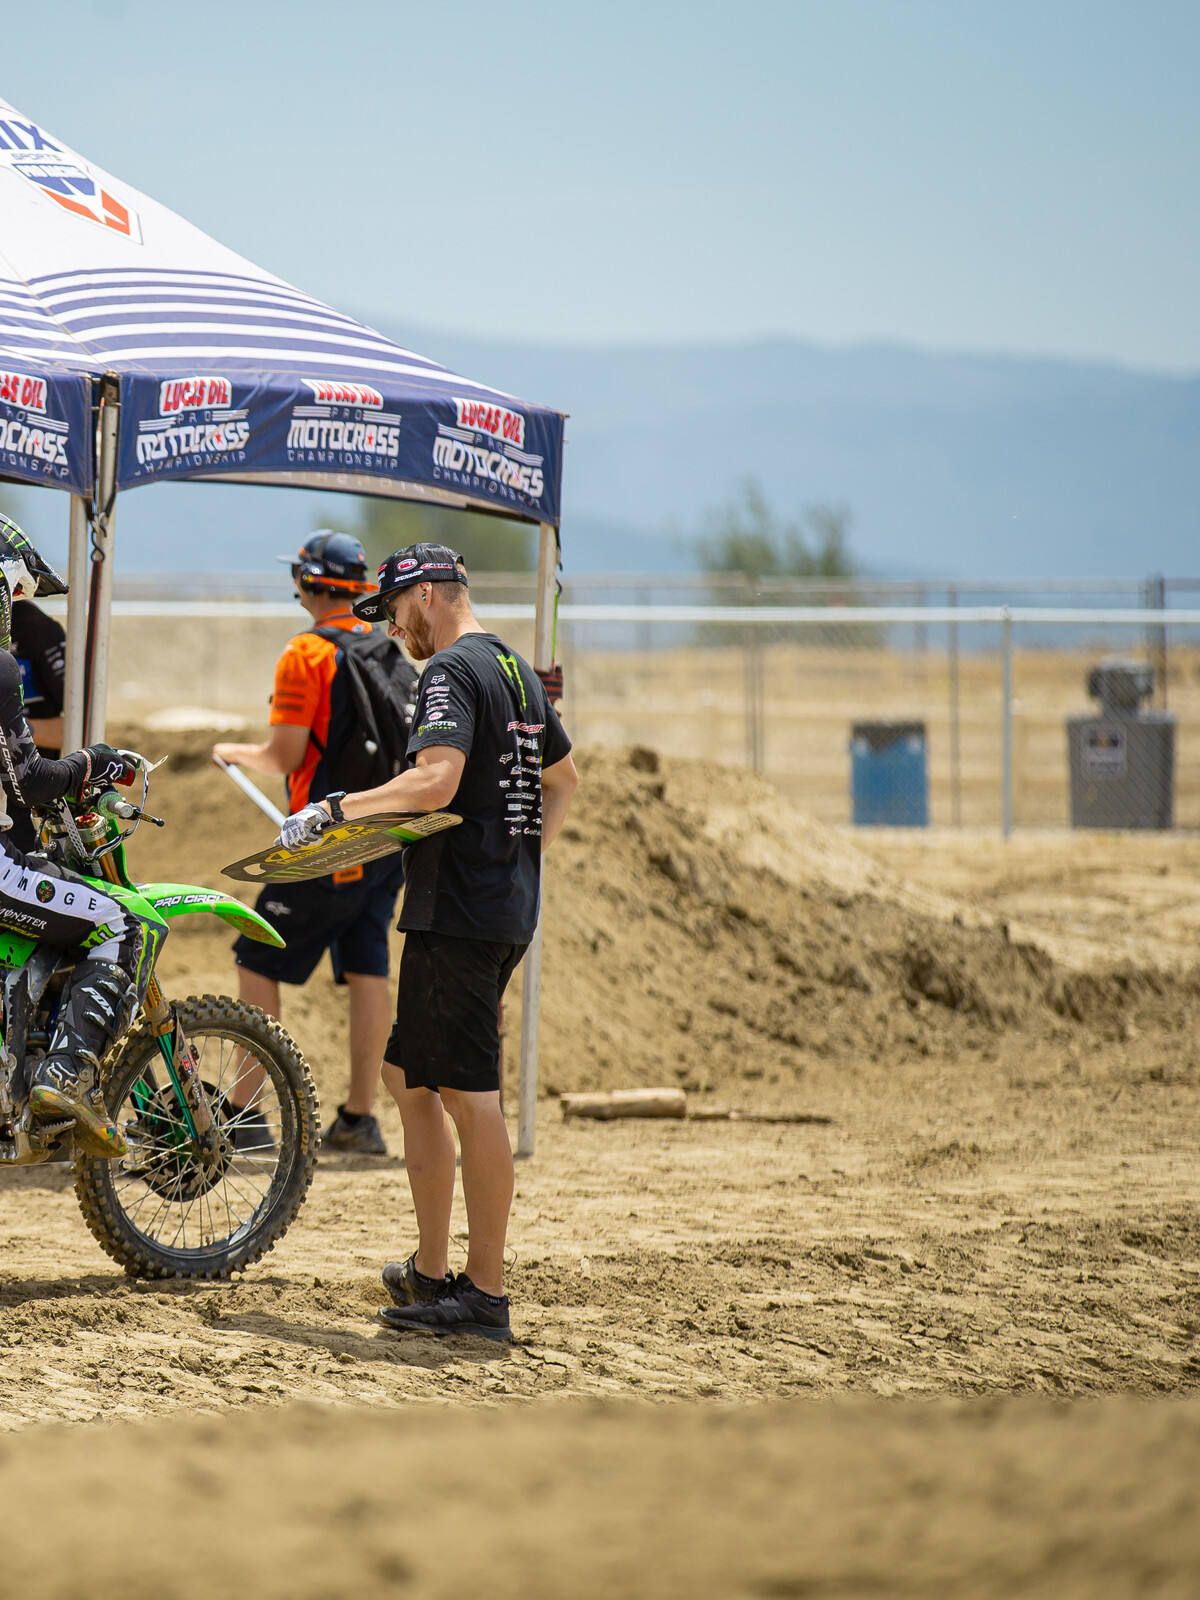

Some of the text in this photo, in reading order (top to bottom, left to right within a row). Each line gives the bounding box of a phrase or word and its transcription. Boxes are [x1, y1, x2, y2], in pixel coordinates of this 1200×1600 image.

[21, 378, 43, 409] OIL
[163, 379, 229, 411] LUCAS OIL
[177, 410, 212, 425] PRO
[331, 407, 363, 421] PRO
[461, 400, 521, 443] LUCAS OIL
[136, 422, 250, 465] MOTOCROSS
[287, 419, 401, 458] MOTOCROSS
[287, 450, 398, 470] CHAMPIONSHIP
[432, 436, 544, 499] MOTOCROSS
[1, 748, 26, 805] CIRCUIT
[153, 895, 182, 910] PRO
[81, 986, 116, 1017] FOX
[295, 1088, 310, 1156] DUNLOP
